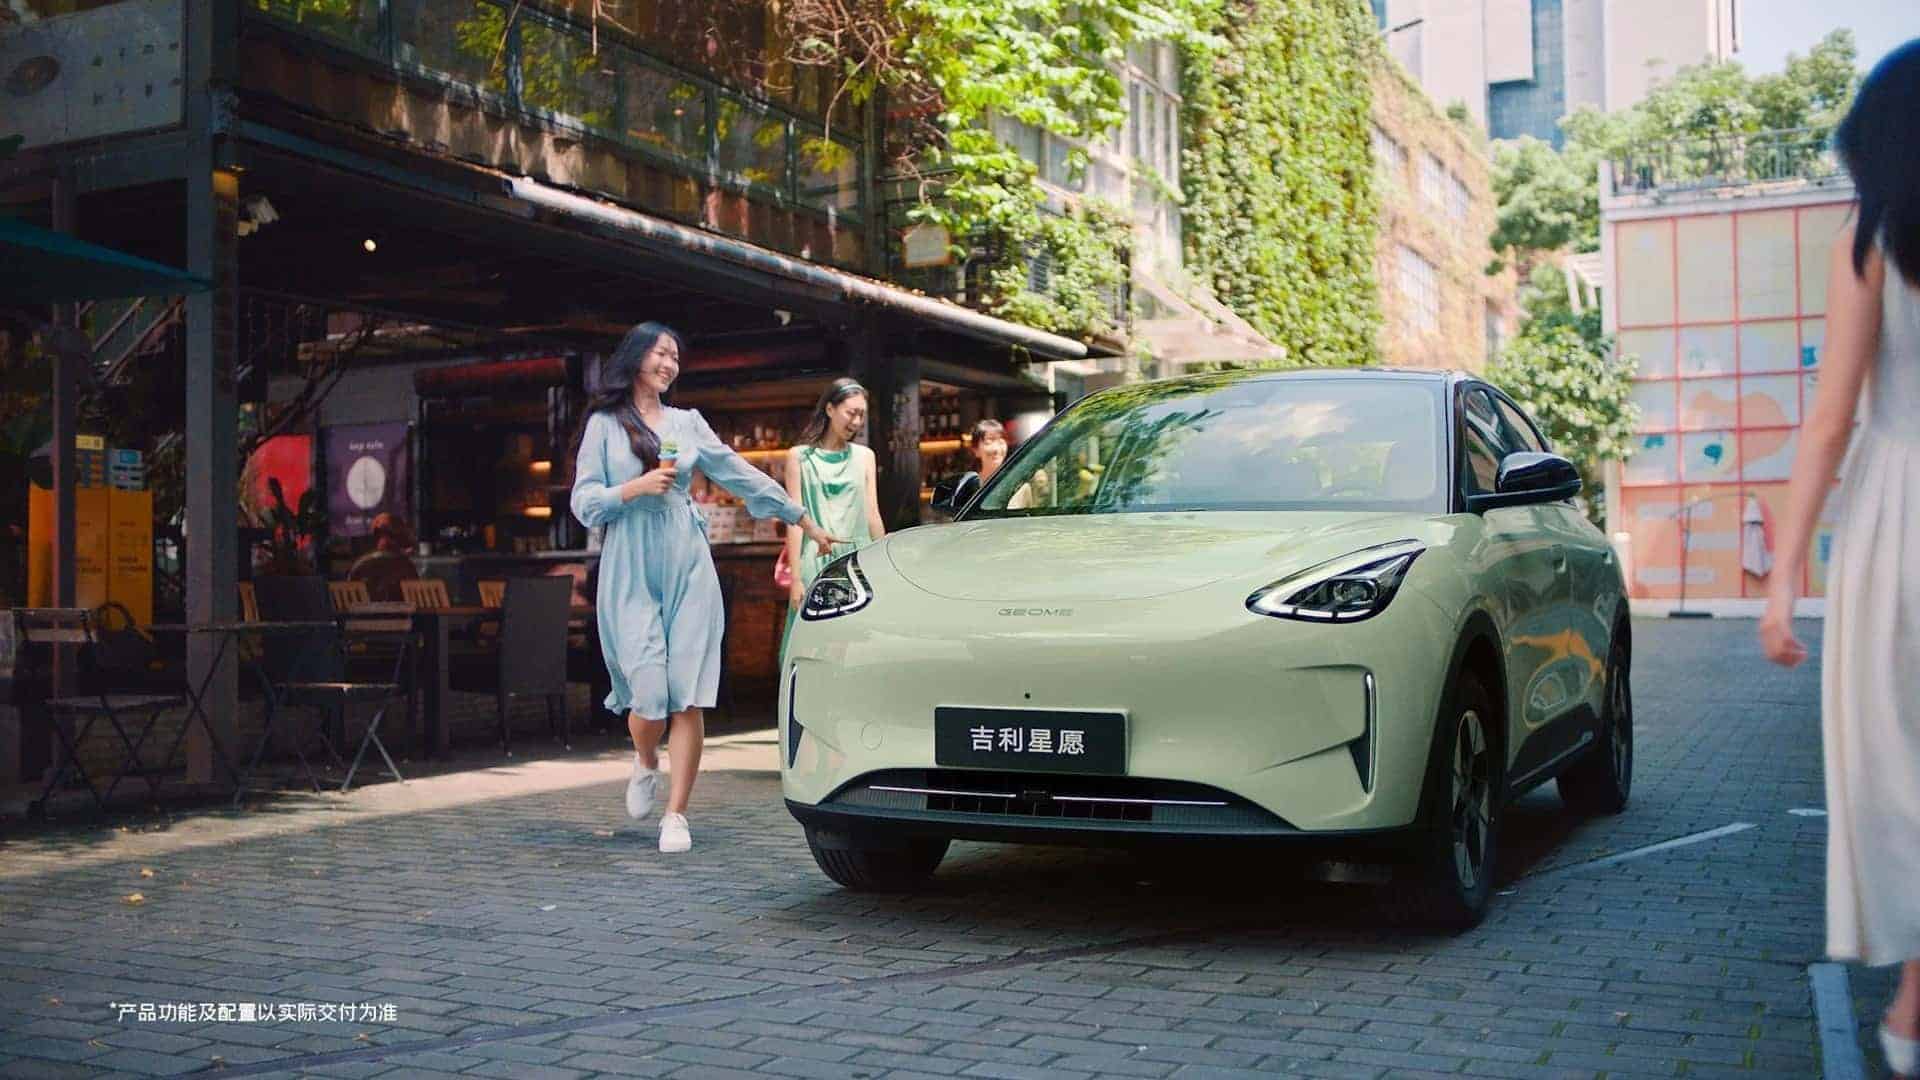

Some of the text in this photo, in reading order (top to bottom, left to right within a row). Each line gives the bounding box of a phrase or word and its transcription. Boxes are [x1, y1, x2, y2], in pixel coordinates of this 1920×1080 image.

[998, 608, 1073, 616] GEOME
[970, 726, 1085, 754] 吉利星愿
